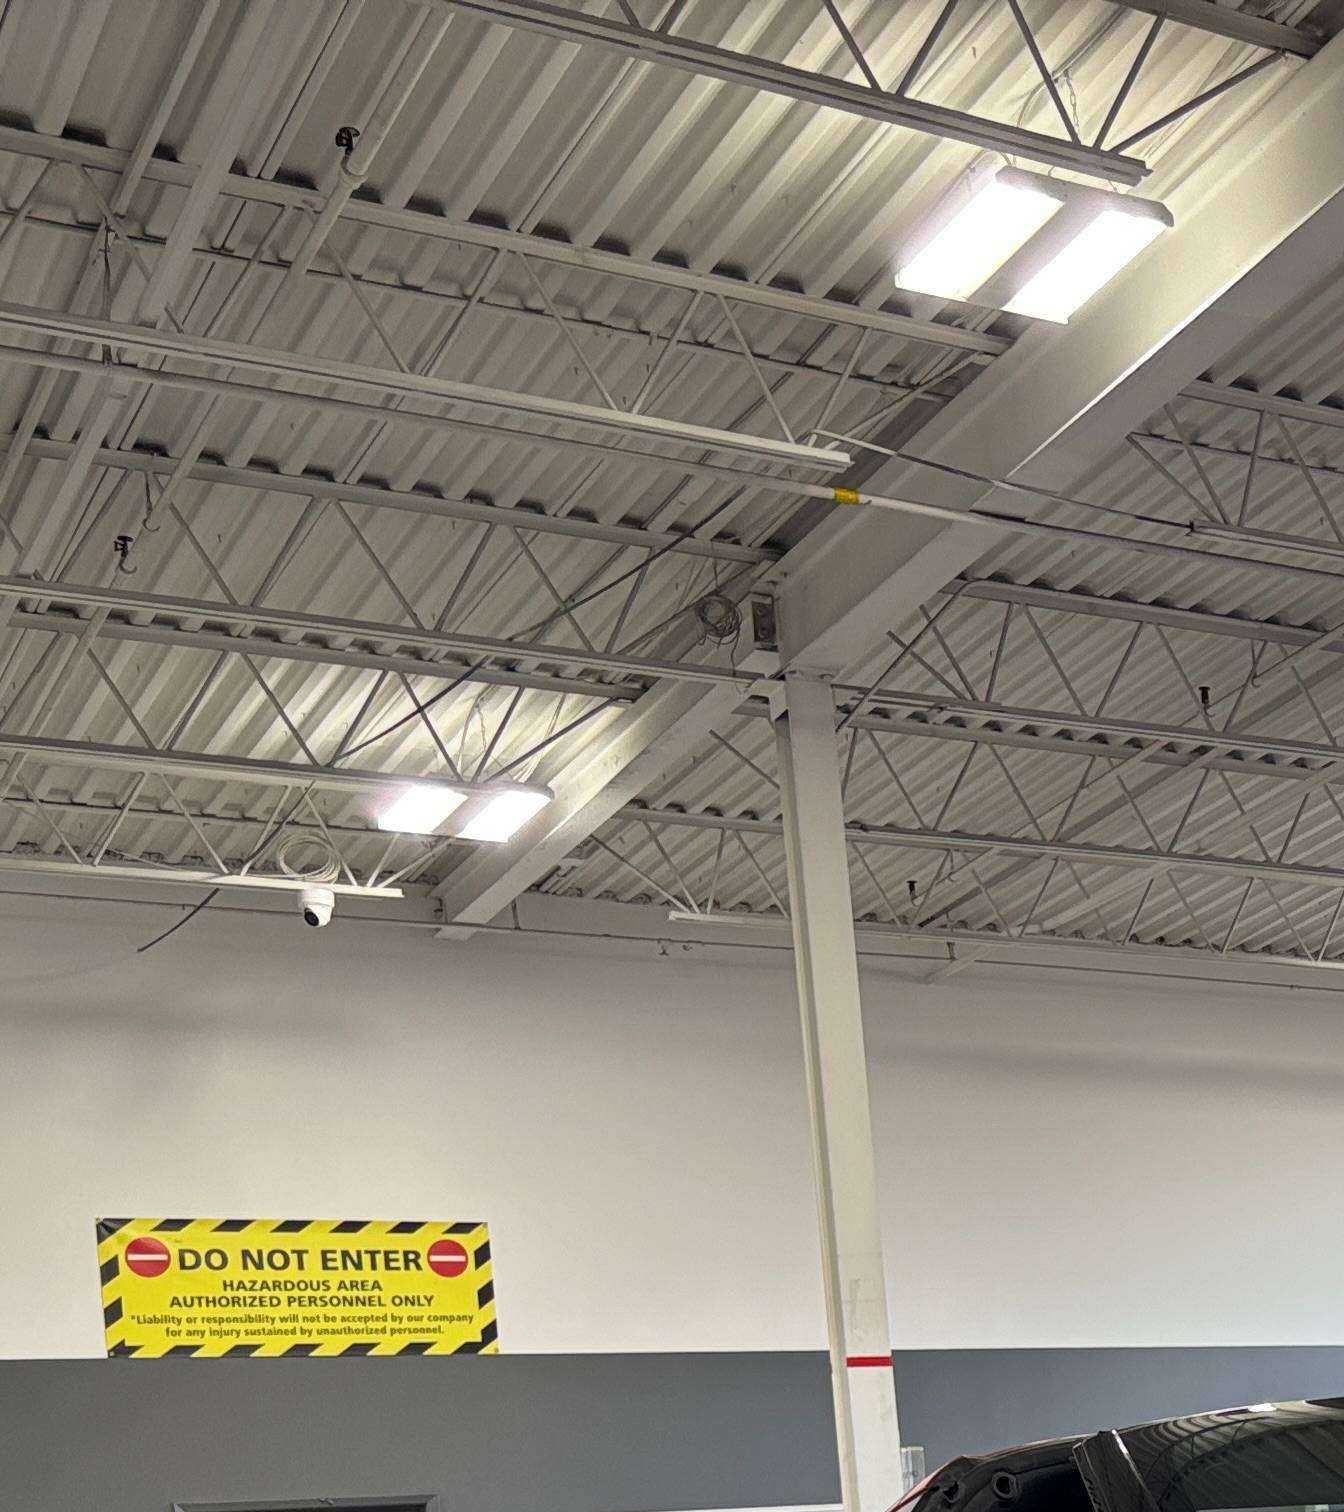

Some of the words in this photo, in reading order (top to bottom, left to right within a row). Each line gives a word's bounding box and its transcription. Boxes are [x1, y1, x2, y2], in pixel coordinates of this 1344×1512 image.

[178, 1248, 229, 1271] DO
[241, 1249, 309, 1271] NOT
[321, 1249, 423, 1271] ENTER
[222, 1279, 331, 1292] HAZARDOUS
[337, 1279, 383, 1292] AREA
[169, 1295, 282, 1308] AUTHORIZED
[287, 1295, 386, 1308] PERSONNEL
[391, 1294, 434, 1307] ONLY
[186, 1316, 198, 1324] or
[201, 1314, 276, 1326] responsibility
[279, 1314, 300, 1324] will
[302, 1314, 321, 1323] not
[324, 1314, 337, 1323] be
[341, 1313, 388, 1325] accepted
[391, 1313, 404, 1325] by
[407, 1314, 424, 1323] our
[427, 1314, 474, 1325] company
[165, 1327, 181, 1337] for
[186, 1329, 206, 1339] any
[209, 1327, 241, 1340] injury
[244, 1326, 297, 1336] sustained
[300, 1326, 313, 1337] by
[316, 1325, 387, 1336] unauthorized
